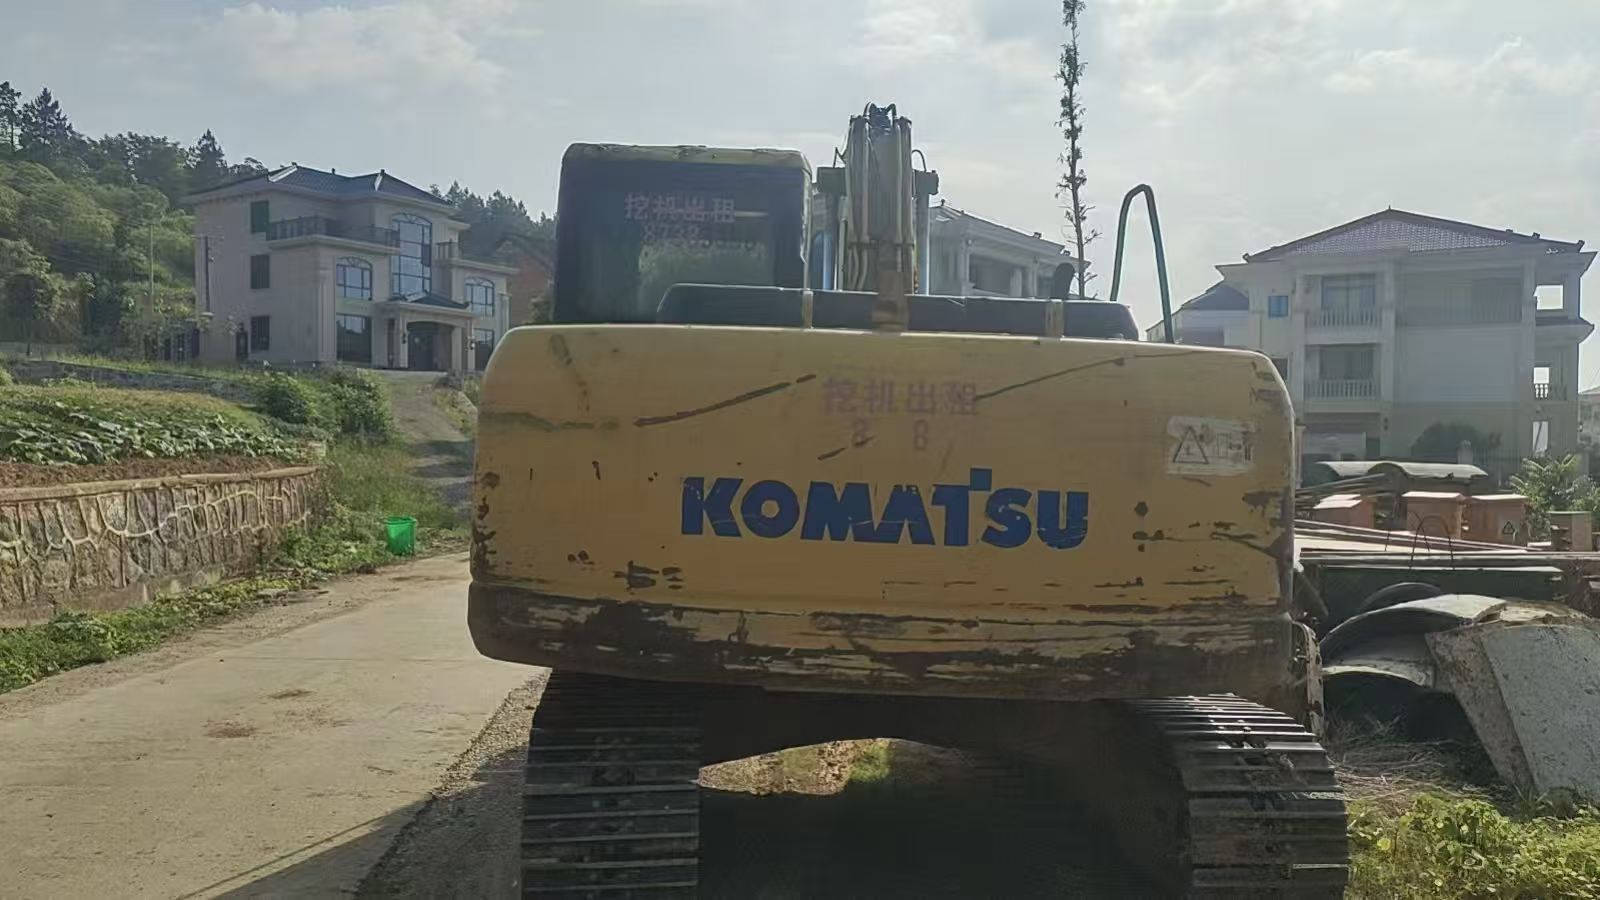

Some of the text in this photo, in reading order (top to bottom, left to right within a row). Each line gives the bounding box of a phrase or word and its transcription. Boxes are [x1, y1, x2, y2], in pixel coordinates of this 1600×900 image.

[821, 377, 979, 416] 挖机出租
[681, 467, 1089, 549] KOMATSU
